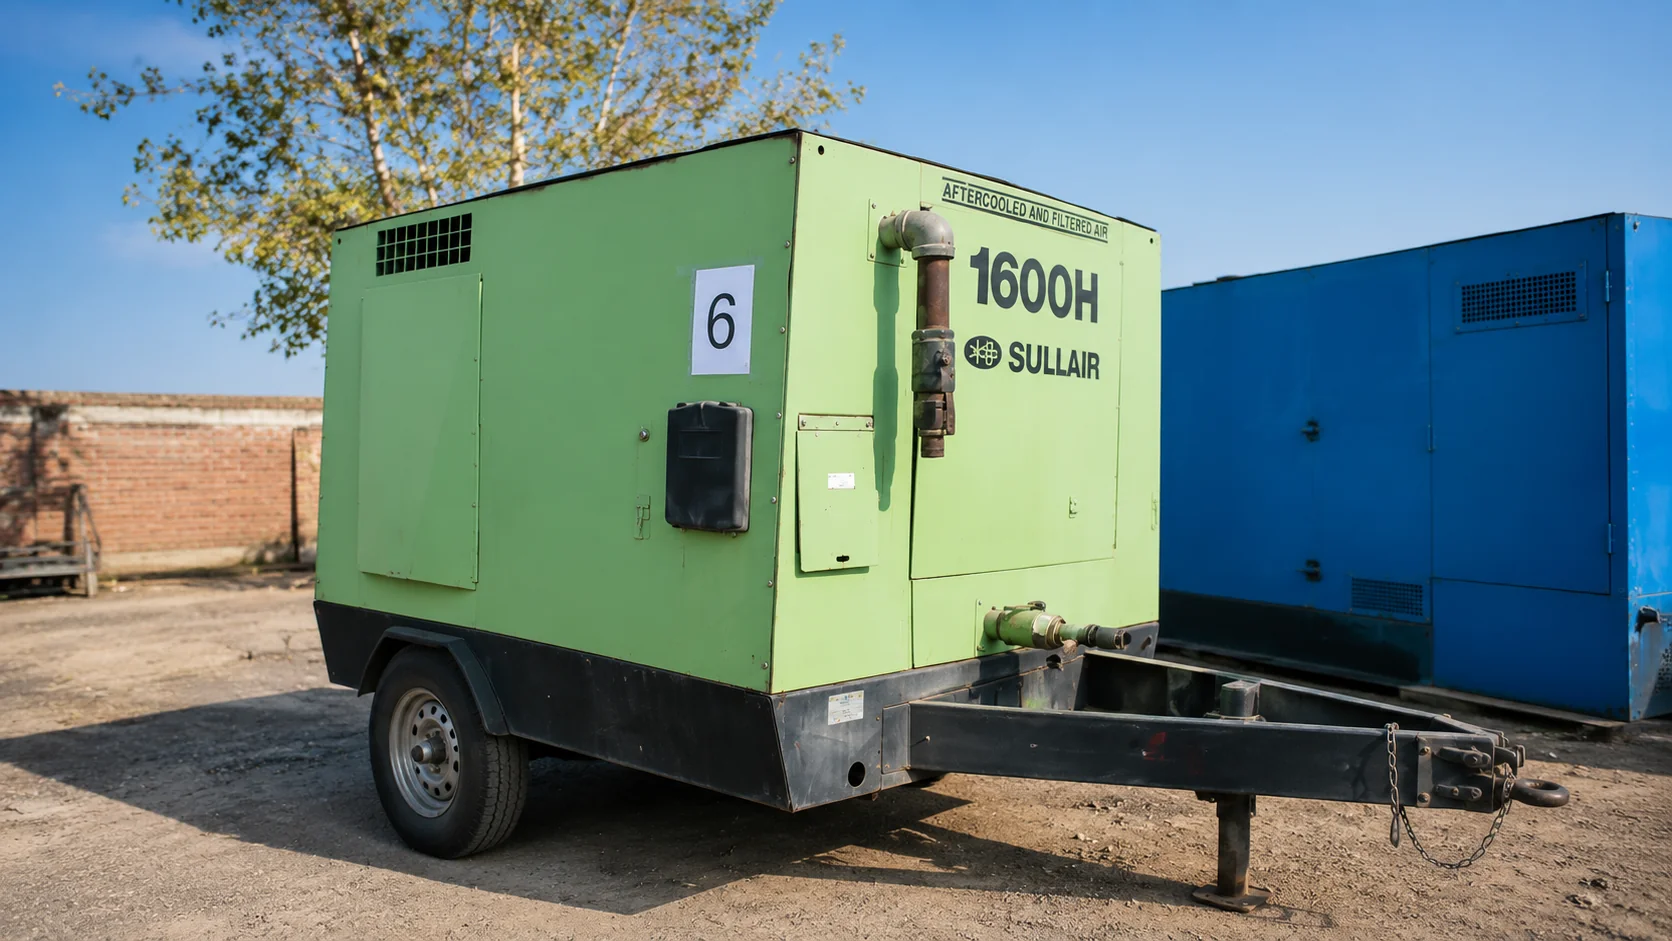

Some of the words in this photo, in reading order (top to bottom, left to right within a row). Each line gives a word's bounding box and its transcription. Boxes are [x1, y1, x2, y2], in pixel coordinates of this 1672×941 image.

[942, 182, 1027, 217] AFTERCOOLED
[1028, 205, 1050, 224] AND
[1051, 211, 1092, 235] FILTERED
[1093, 223, 1109, 240] AIR
[969, 246, 1099, 324] 1600H
[707, 292, 736, 350] 6
[1008, 340, 1100, 380] SULLAIR
